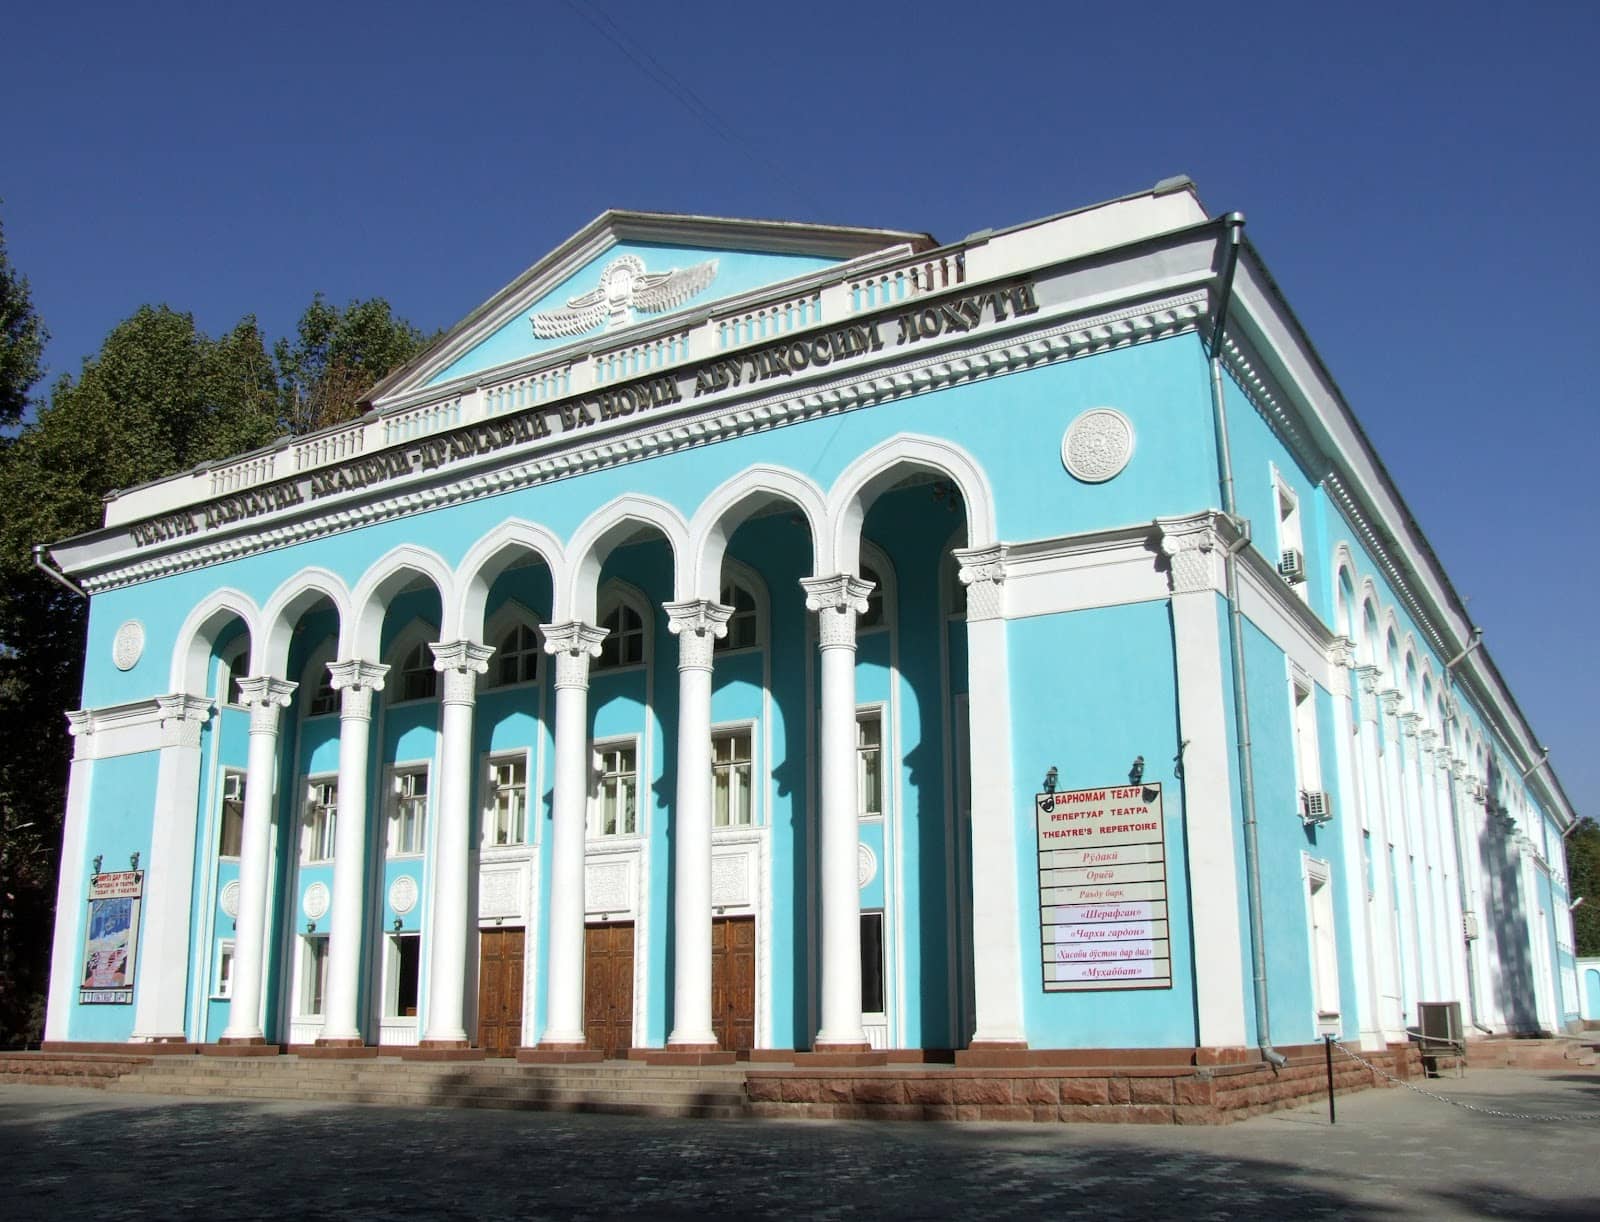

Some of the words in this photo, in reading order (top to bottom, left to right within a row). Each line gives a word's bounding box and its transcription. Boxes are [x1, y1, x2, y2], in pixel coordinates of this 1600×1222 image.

[129, 511, 198, 548] ТЕАТРИ
[600, 376, 682, 422] НОМИ
[1110, 788, 1141, 800] ТЕАТР
[1051, 810, 1104, 822] РЕПЕРТУАР
[1110, 806, 1148, 816] ТЕАТРА
[1043, 827, 1093, 839] THEATRE'S
[1099, 822, 1157, 834] REPERTOIRE
